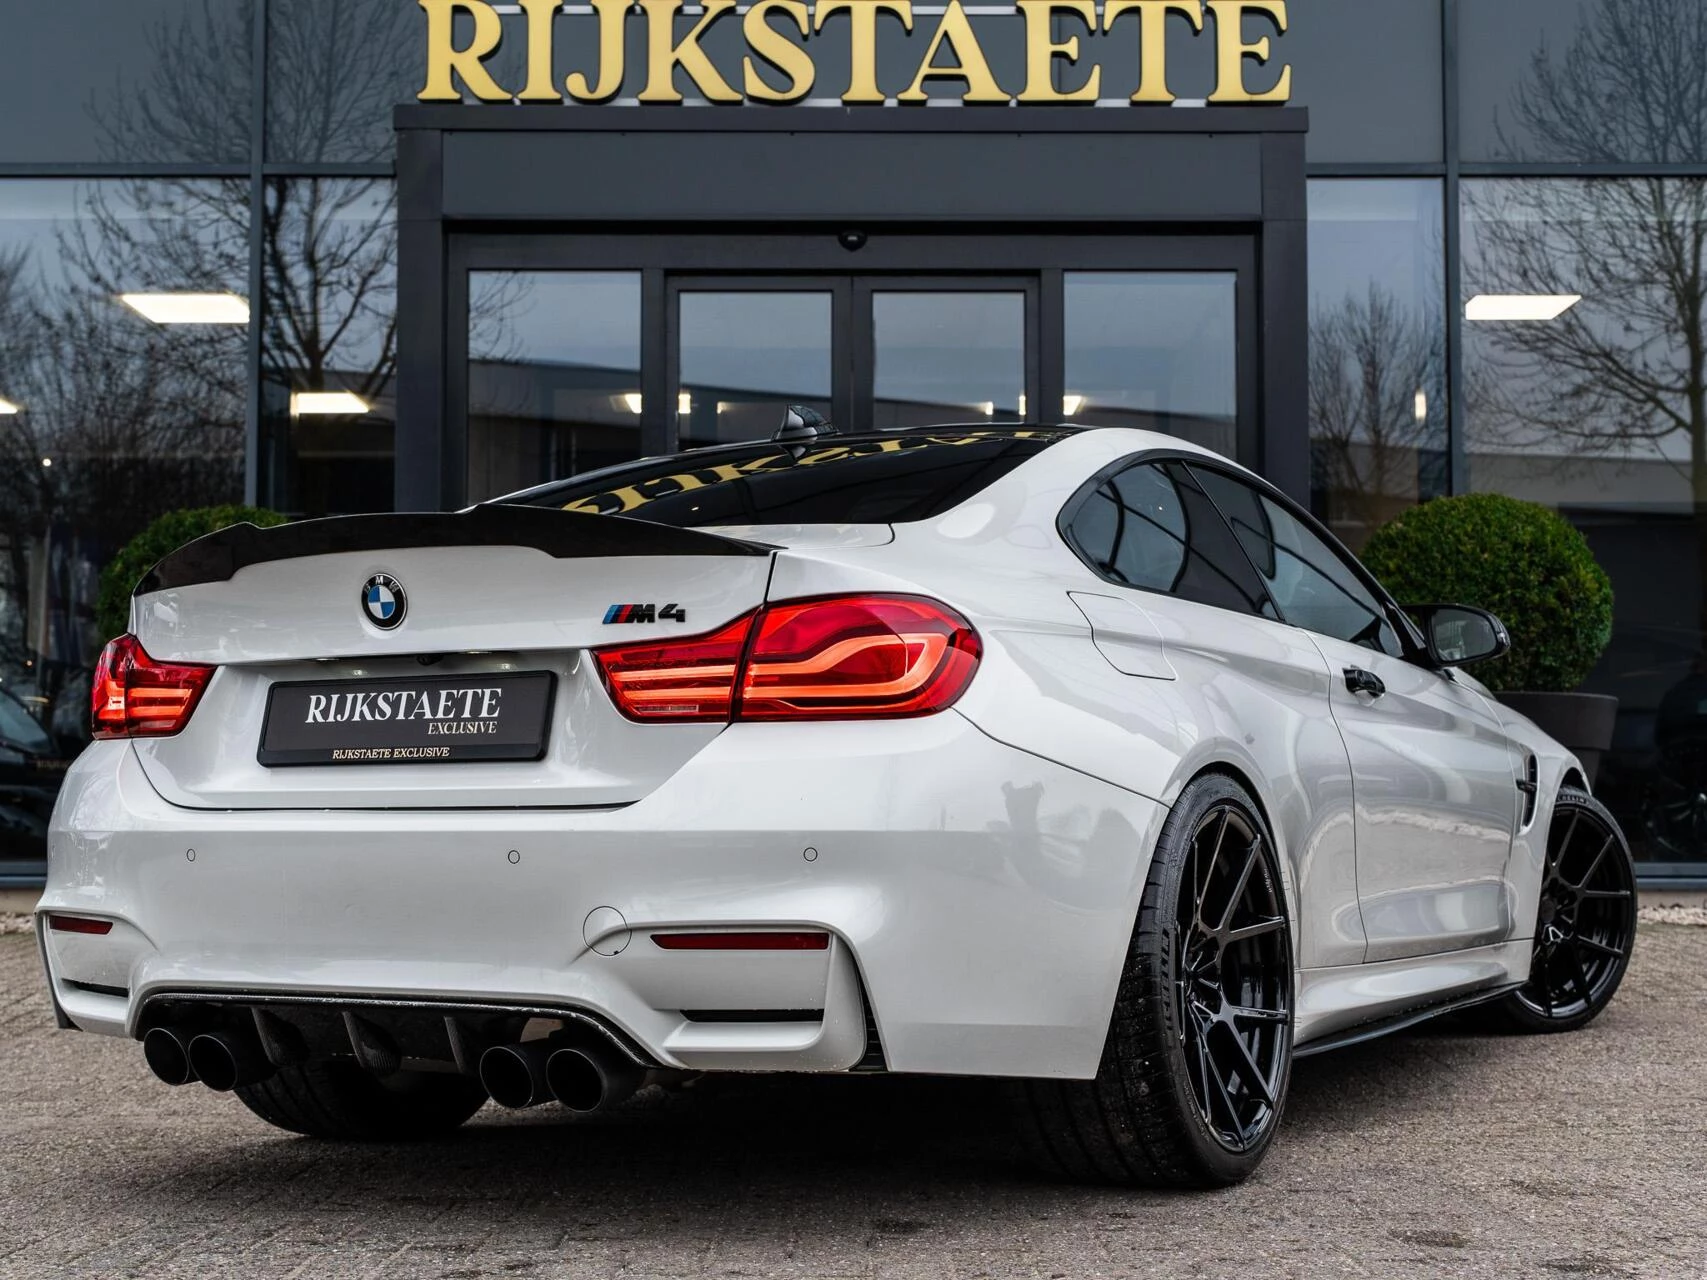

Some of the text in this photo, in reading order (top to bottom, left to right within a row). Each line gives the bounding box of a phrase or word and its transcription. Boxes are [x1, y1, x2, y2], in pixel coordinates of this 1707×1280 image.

[416, 0, 1292, 104] RIJKSTAETE
[364, 575, 400, 593] BMW
[305, 687, 502, 723] RIJKSTAETE
[427, 721, 498, 736] EXCLUSIVE
[332, 747, 450, 760] RIJKSTAETE EXCLUSIVE
